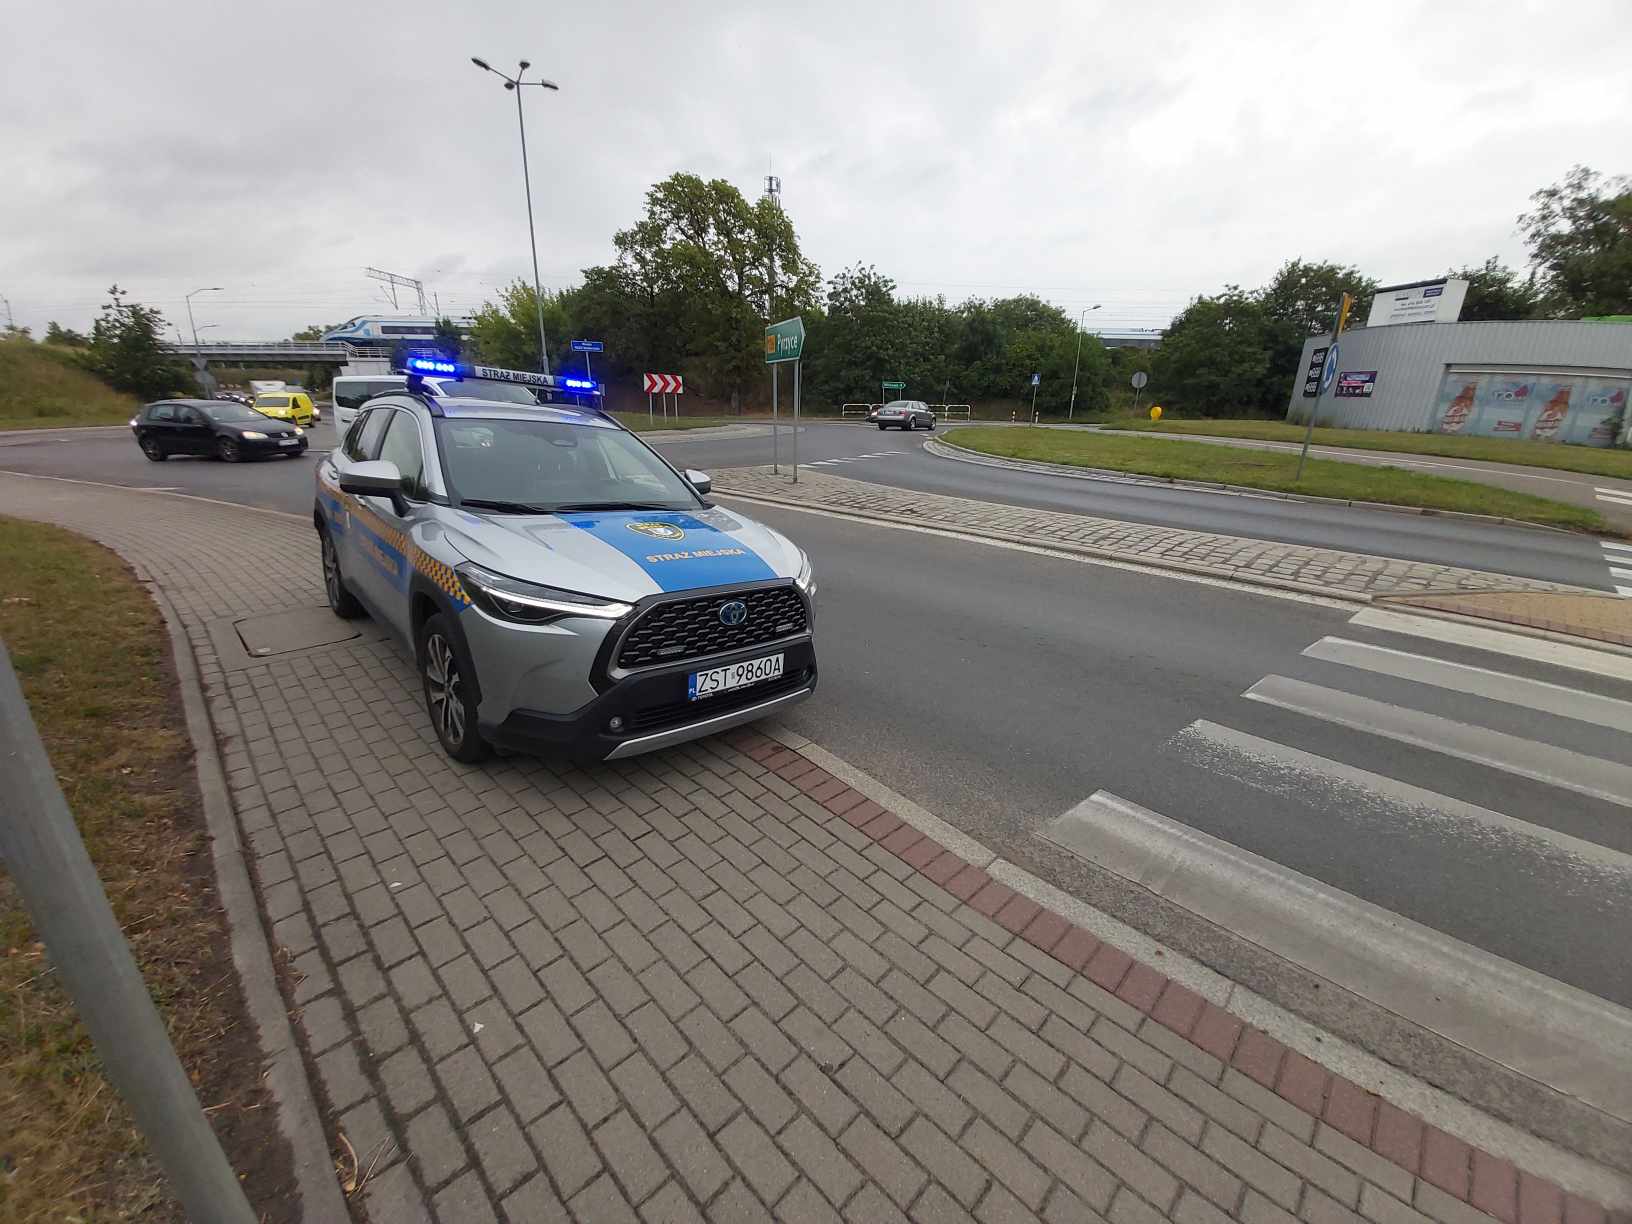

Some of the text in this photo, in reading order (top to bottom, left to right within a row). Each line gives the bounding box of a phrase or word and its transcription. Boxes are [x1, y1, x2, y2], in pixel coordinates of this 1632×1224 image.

[512, 372, 549, 385] MIEJSKA
[692, 548, 745, 558] MIEJSKA
[698, 667, 731, 693] ZST
[736, 656, 781, 684] 9860A
